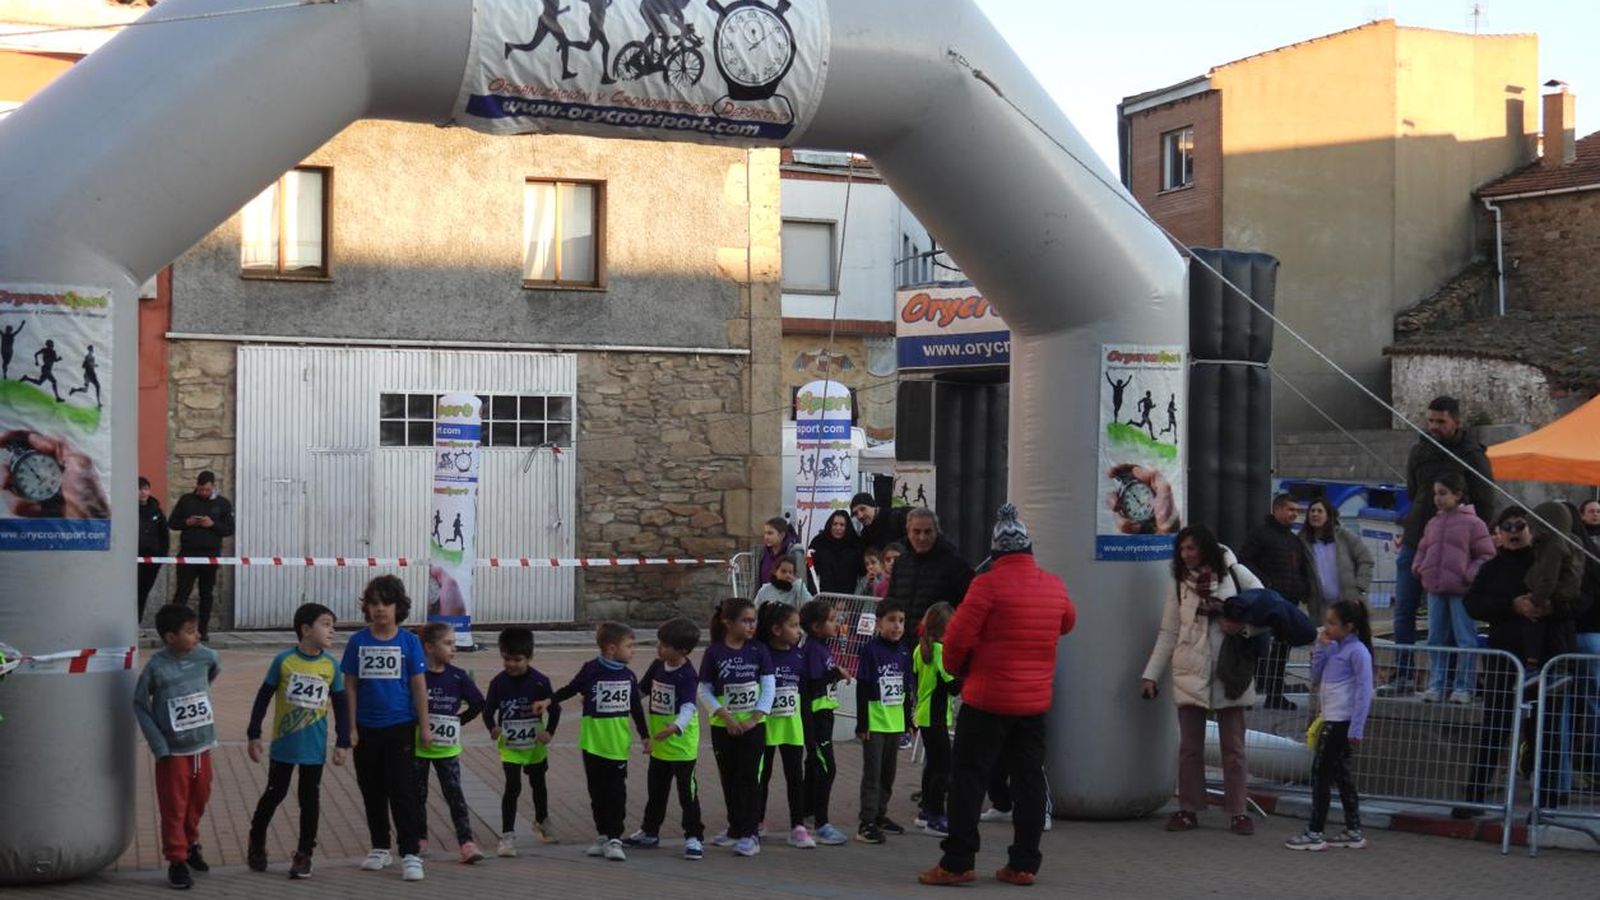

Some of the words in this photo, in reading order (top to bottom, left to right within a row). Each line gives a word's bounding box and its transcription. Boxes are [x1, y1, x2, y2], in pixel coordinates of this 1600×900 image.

[502, 100, 761, 136] www.orycronsport.com
[901, 293, 1001, 328] Orycr
[364, 655, 396, 669] 230
[292, 682, 323, 699] 241
[601, 689, 628, 703] 245
[729, 690, 756, 705] 232
[175, 701, 208, 720] 235
[507, 728, 537, 741] 244
